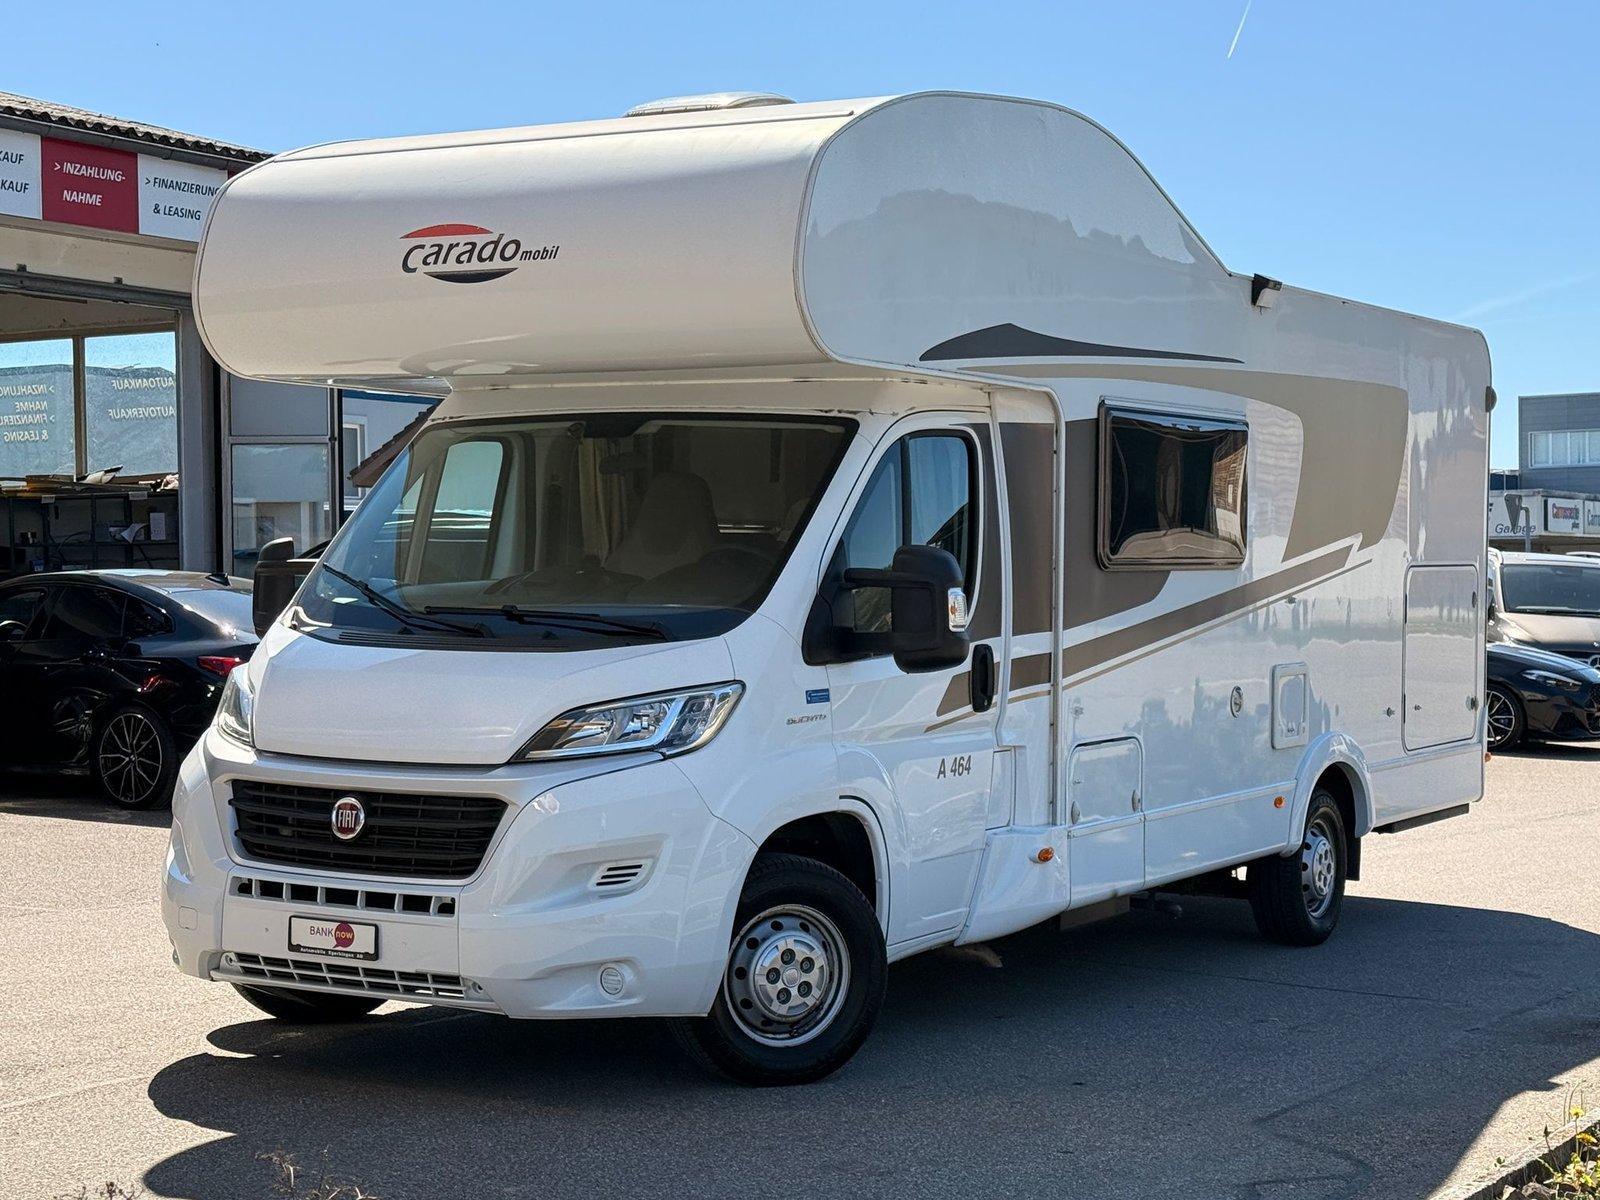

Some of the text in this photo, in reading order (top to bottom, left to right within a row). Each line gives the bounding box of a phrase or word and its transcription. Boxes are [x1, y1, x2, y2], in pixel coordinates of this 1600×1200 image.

[63, 161, 126, 182] INZAHLUNG-
[62, 189, 103, 206] NAHME
[153, 203, 202, 221] & LEASING
[519, 245, 560, 261] mobil
[937, 755, 971, 779] A 464
[337, 810, 357, 828] FIAT
[309, 925, 353, 940] BANK now
